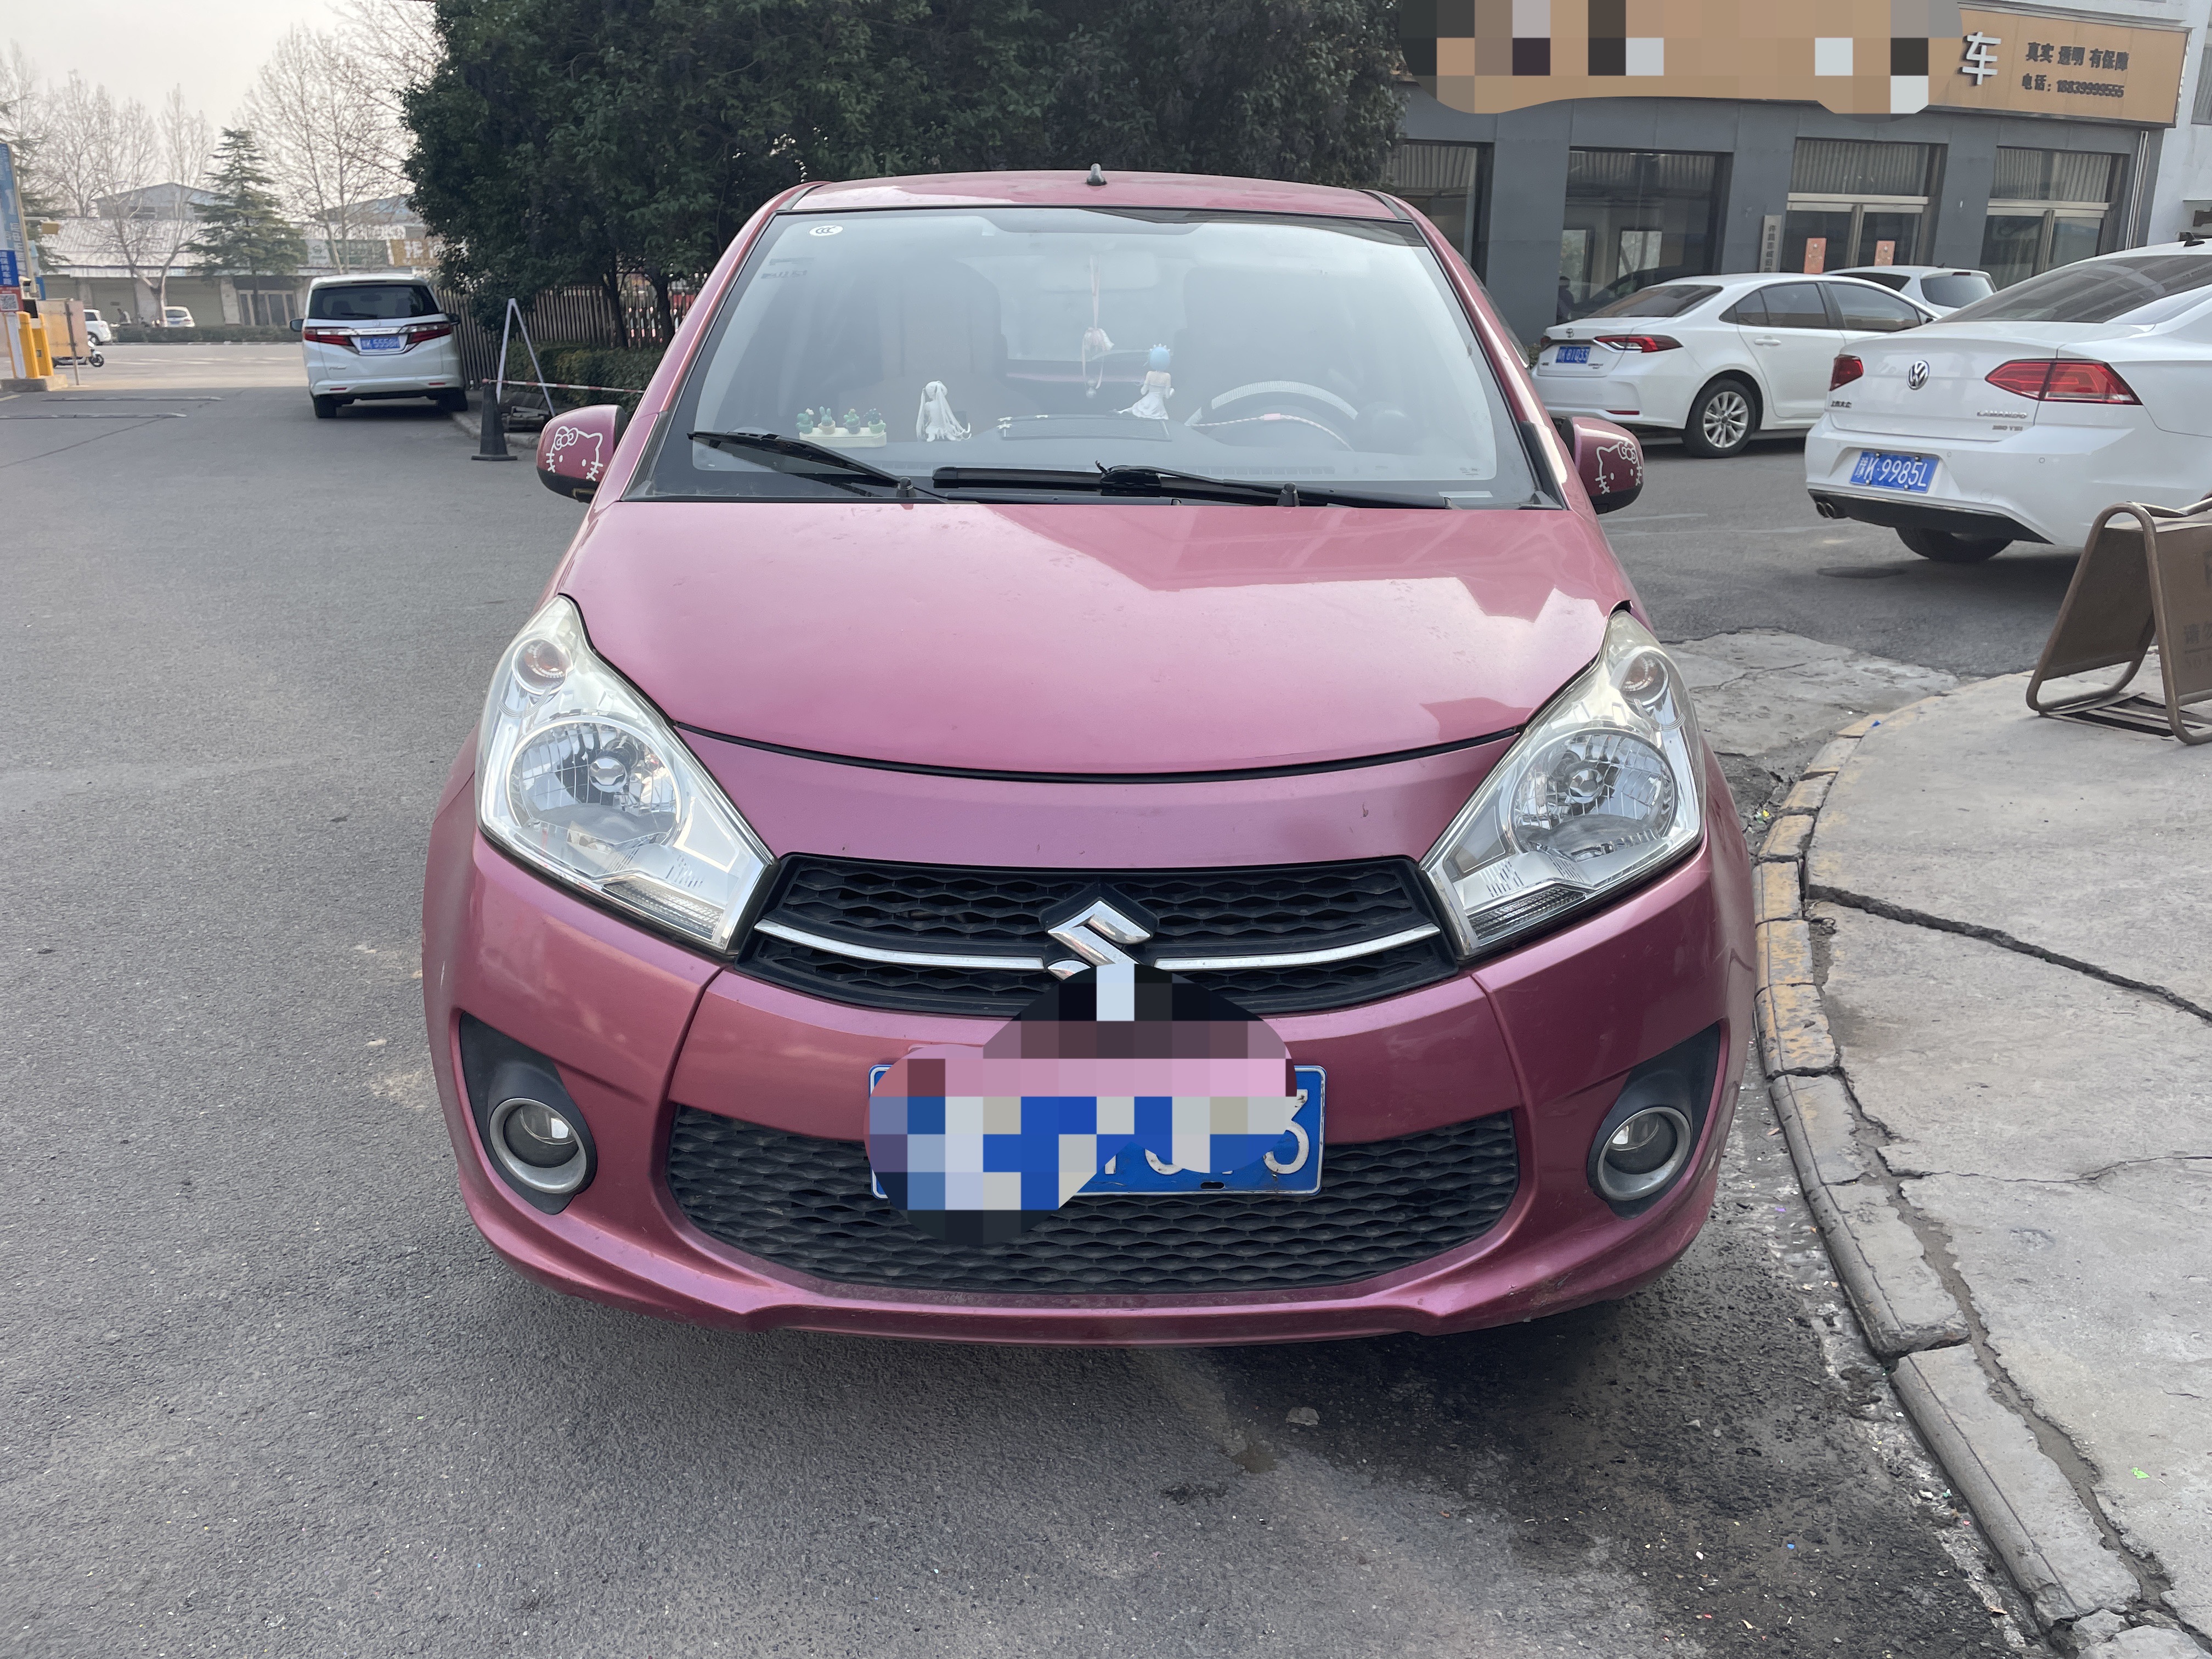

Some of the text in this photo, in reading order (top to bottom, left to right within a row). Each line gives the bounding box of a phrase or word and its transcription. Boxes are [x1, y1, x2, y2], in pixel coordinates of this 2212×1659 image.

[1962, 31, 2001, 85] 车
[2025, 42, 2129, 71] 真实 透明 有保障
